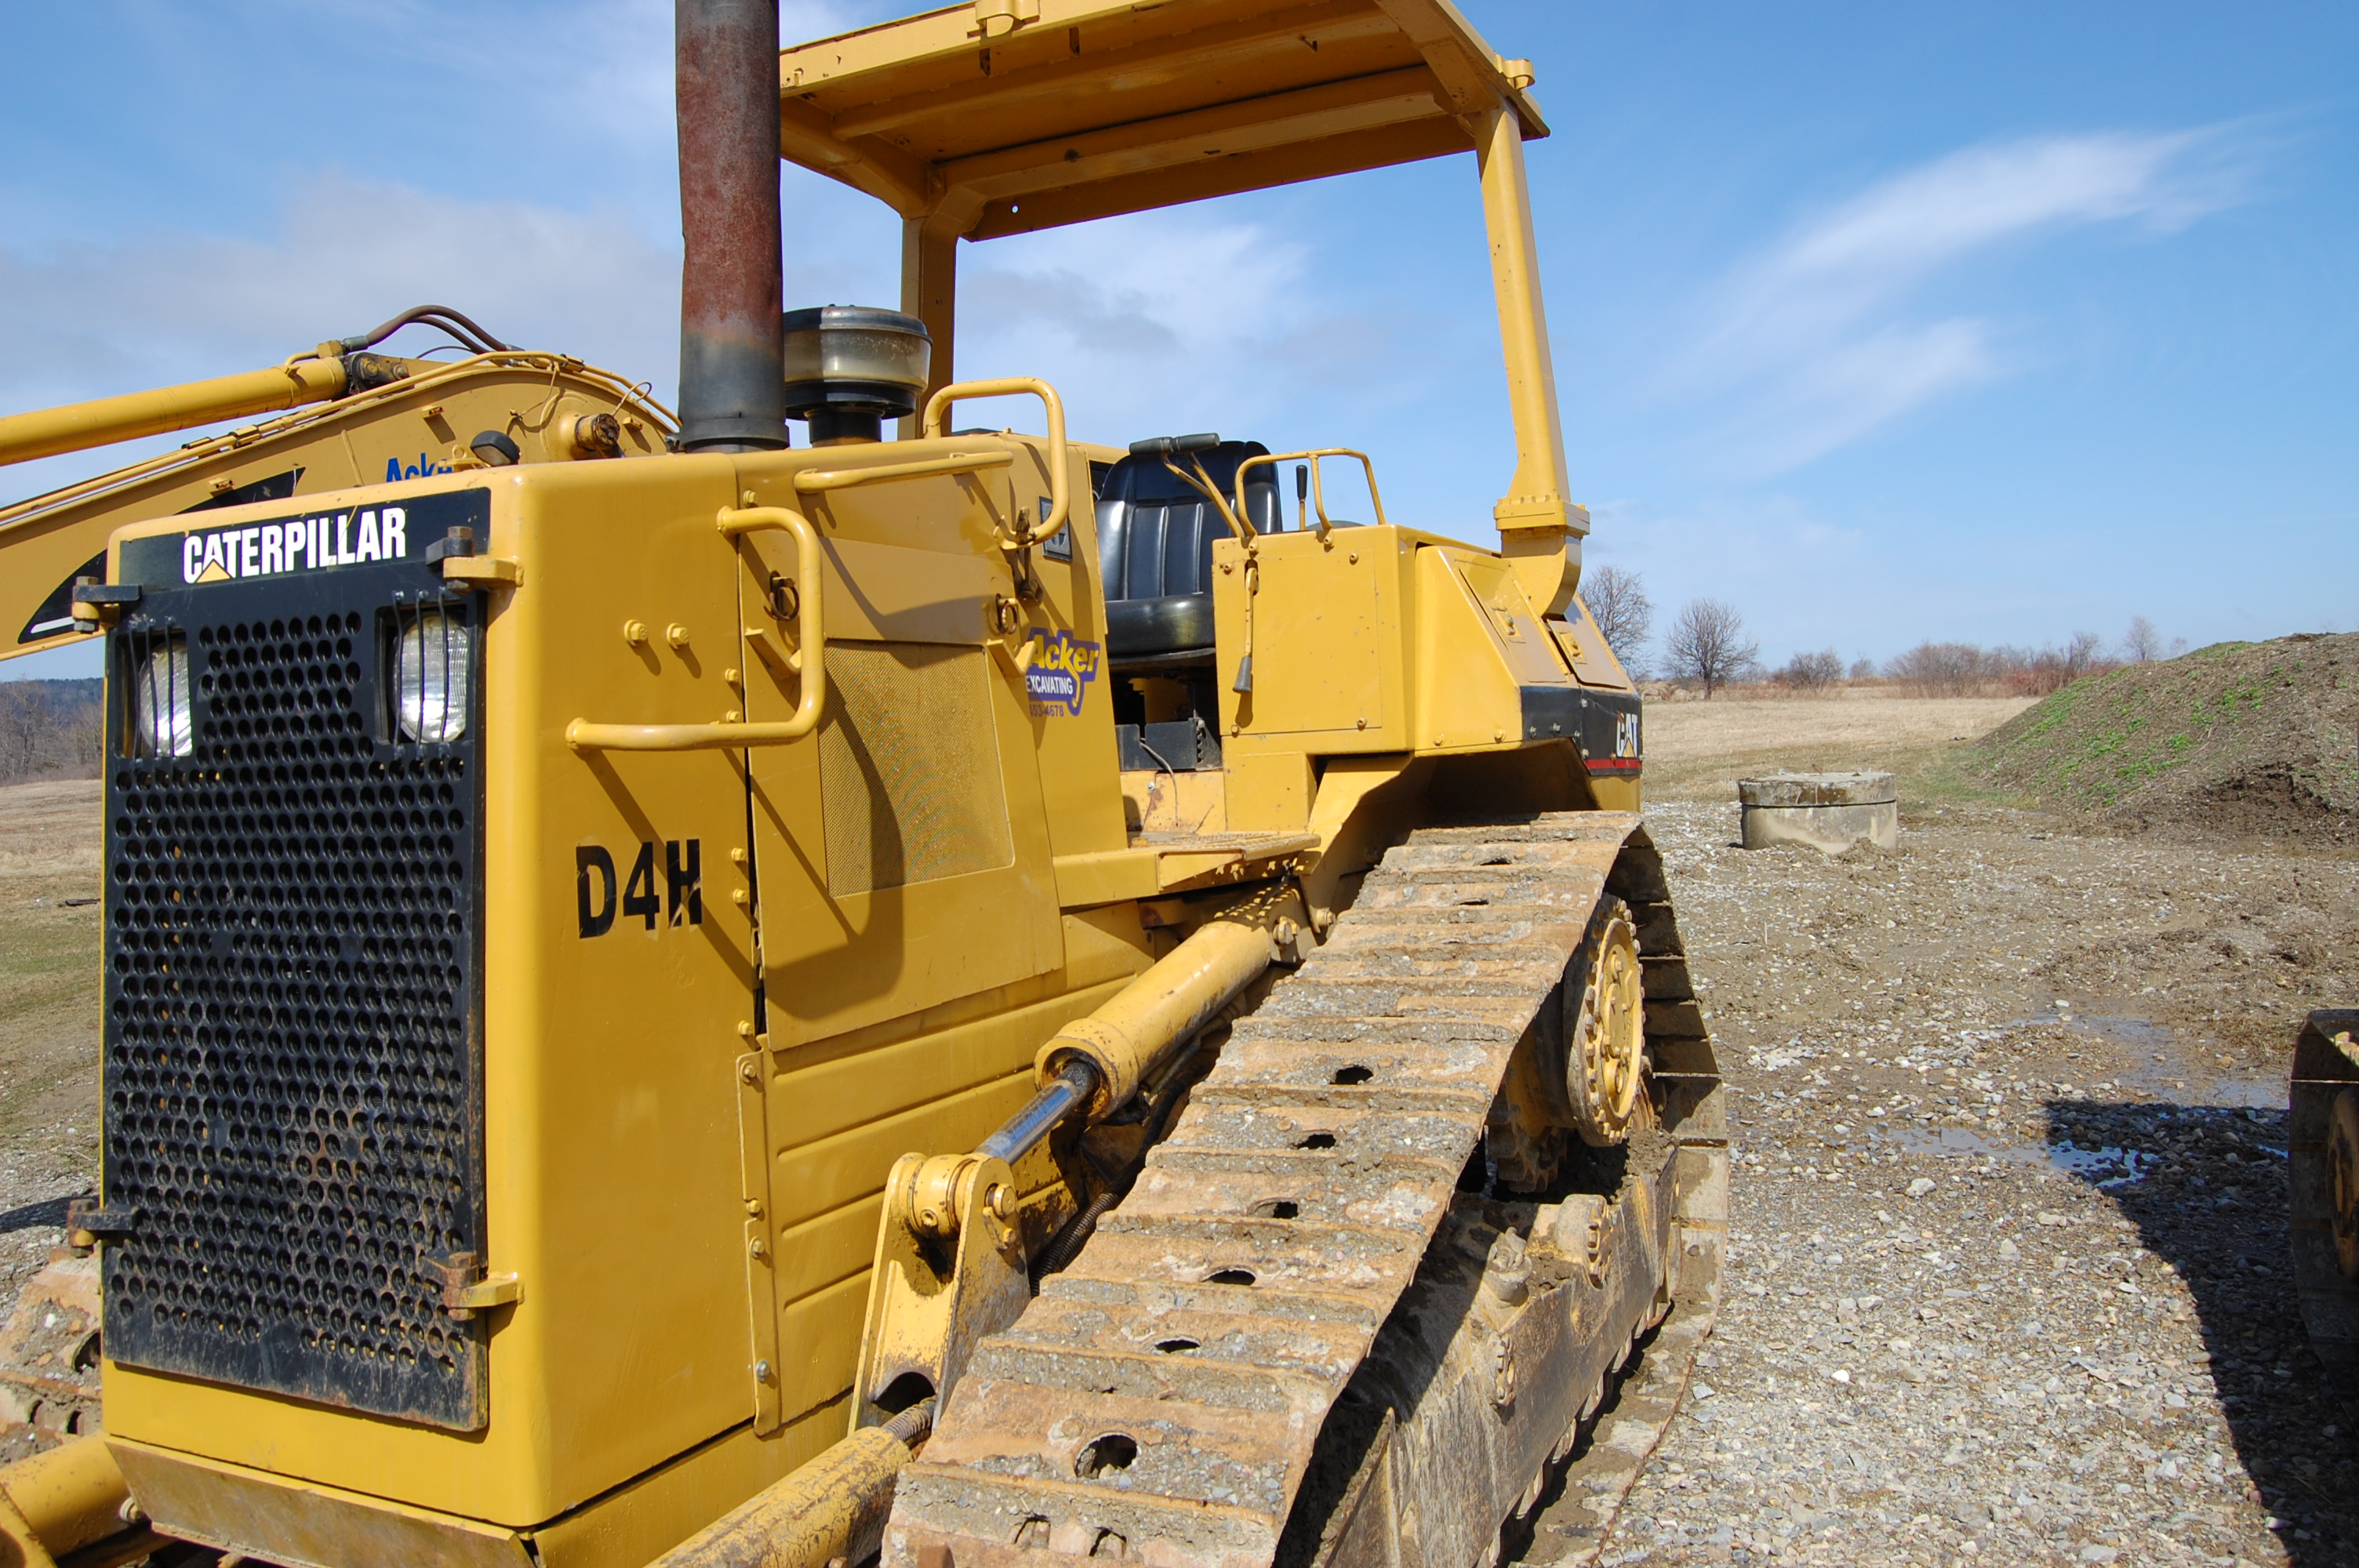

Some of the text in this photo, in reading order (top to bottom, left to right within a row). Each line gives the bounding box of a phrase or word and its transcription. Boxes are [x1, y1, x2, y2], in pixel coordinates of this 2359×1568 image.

[183, 506, 406, 583] CATERPILLAR
[1030, 634, 1099, 672] Acker
[1026, 675, 1073, 695] EXCAVATING
[1616, 710, 1637, 758] CAT
[576, 838, 703, 939] D4H
